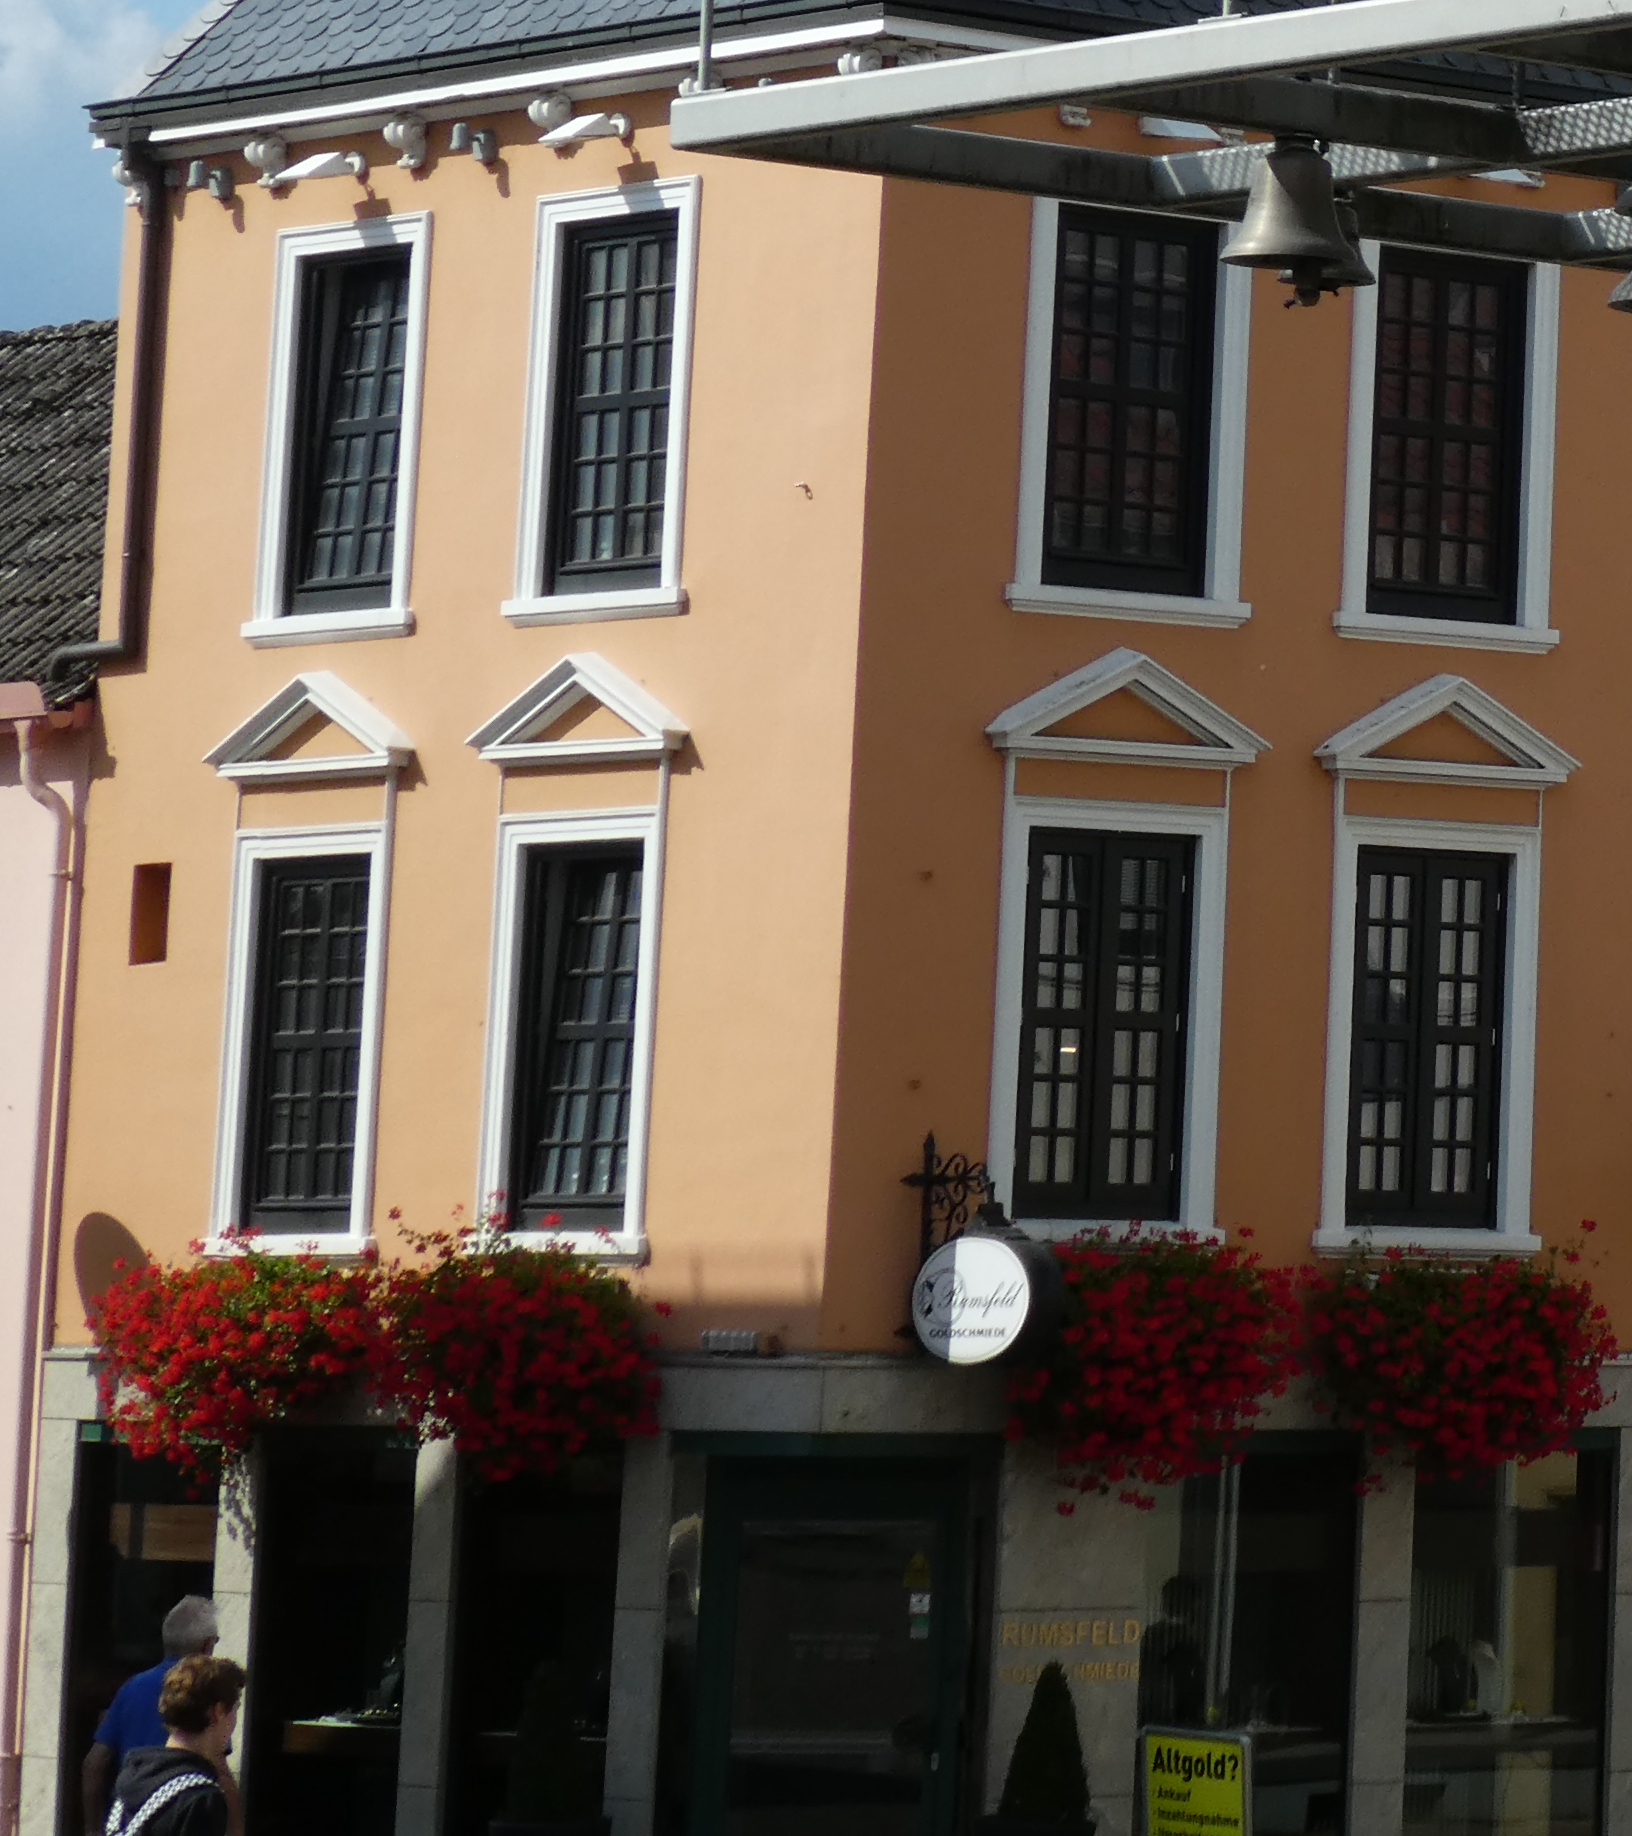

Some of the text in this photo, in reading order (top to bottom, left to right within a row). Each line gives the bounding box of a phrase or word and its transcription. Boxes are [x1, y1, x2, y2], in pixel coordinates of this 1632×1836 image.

[938, 1280, 1024, 1318] Rumsfeld
[929, 1326, 1007, 1339] GOLDSCHMIEDE
[1001, 1618, 1141, 1647] RUMSFELD
[1152, 1745, 1239, 1782] Altgold?
